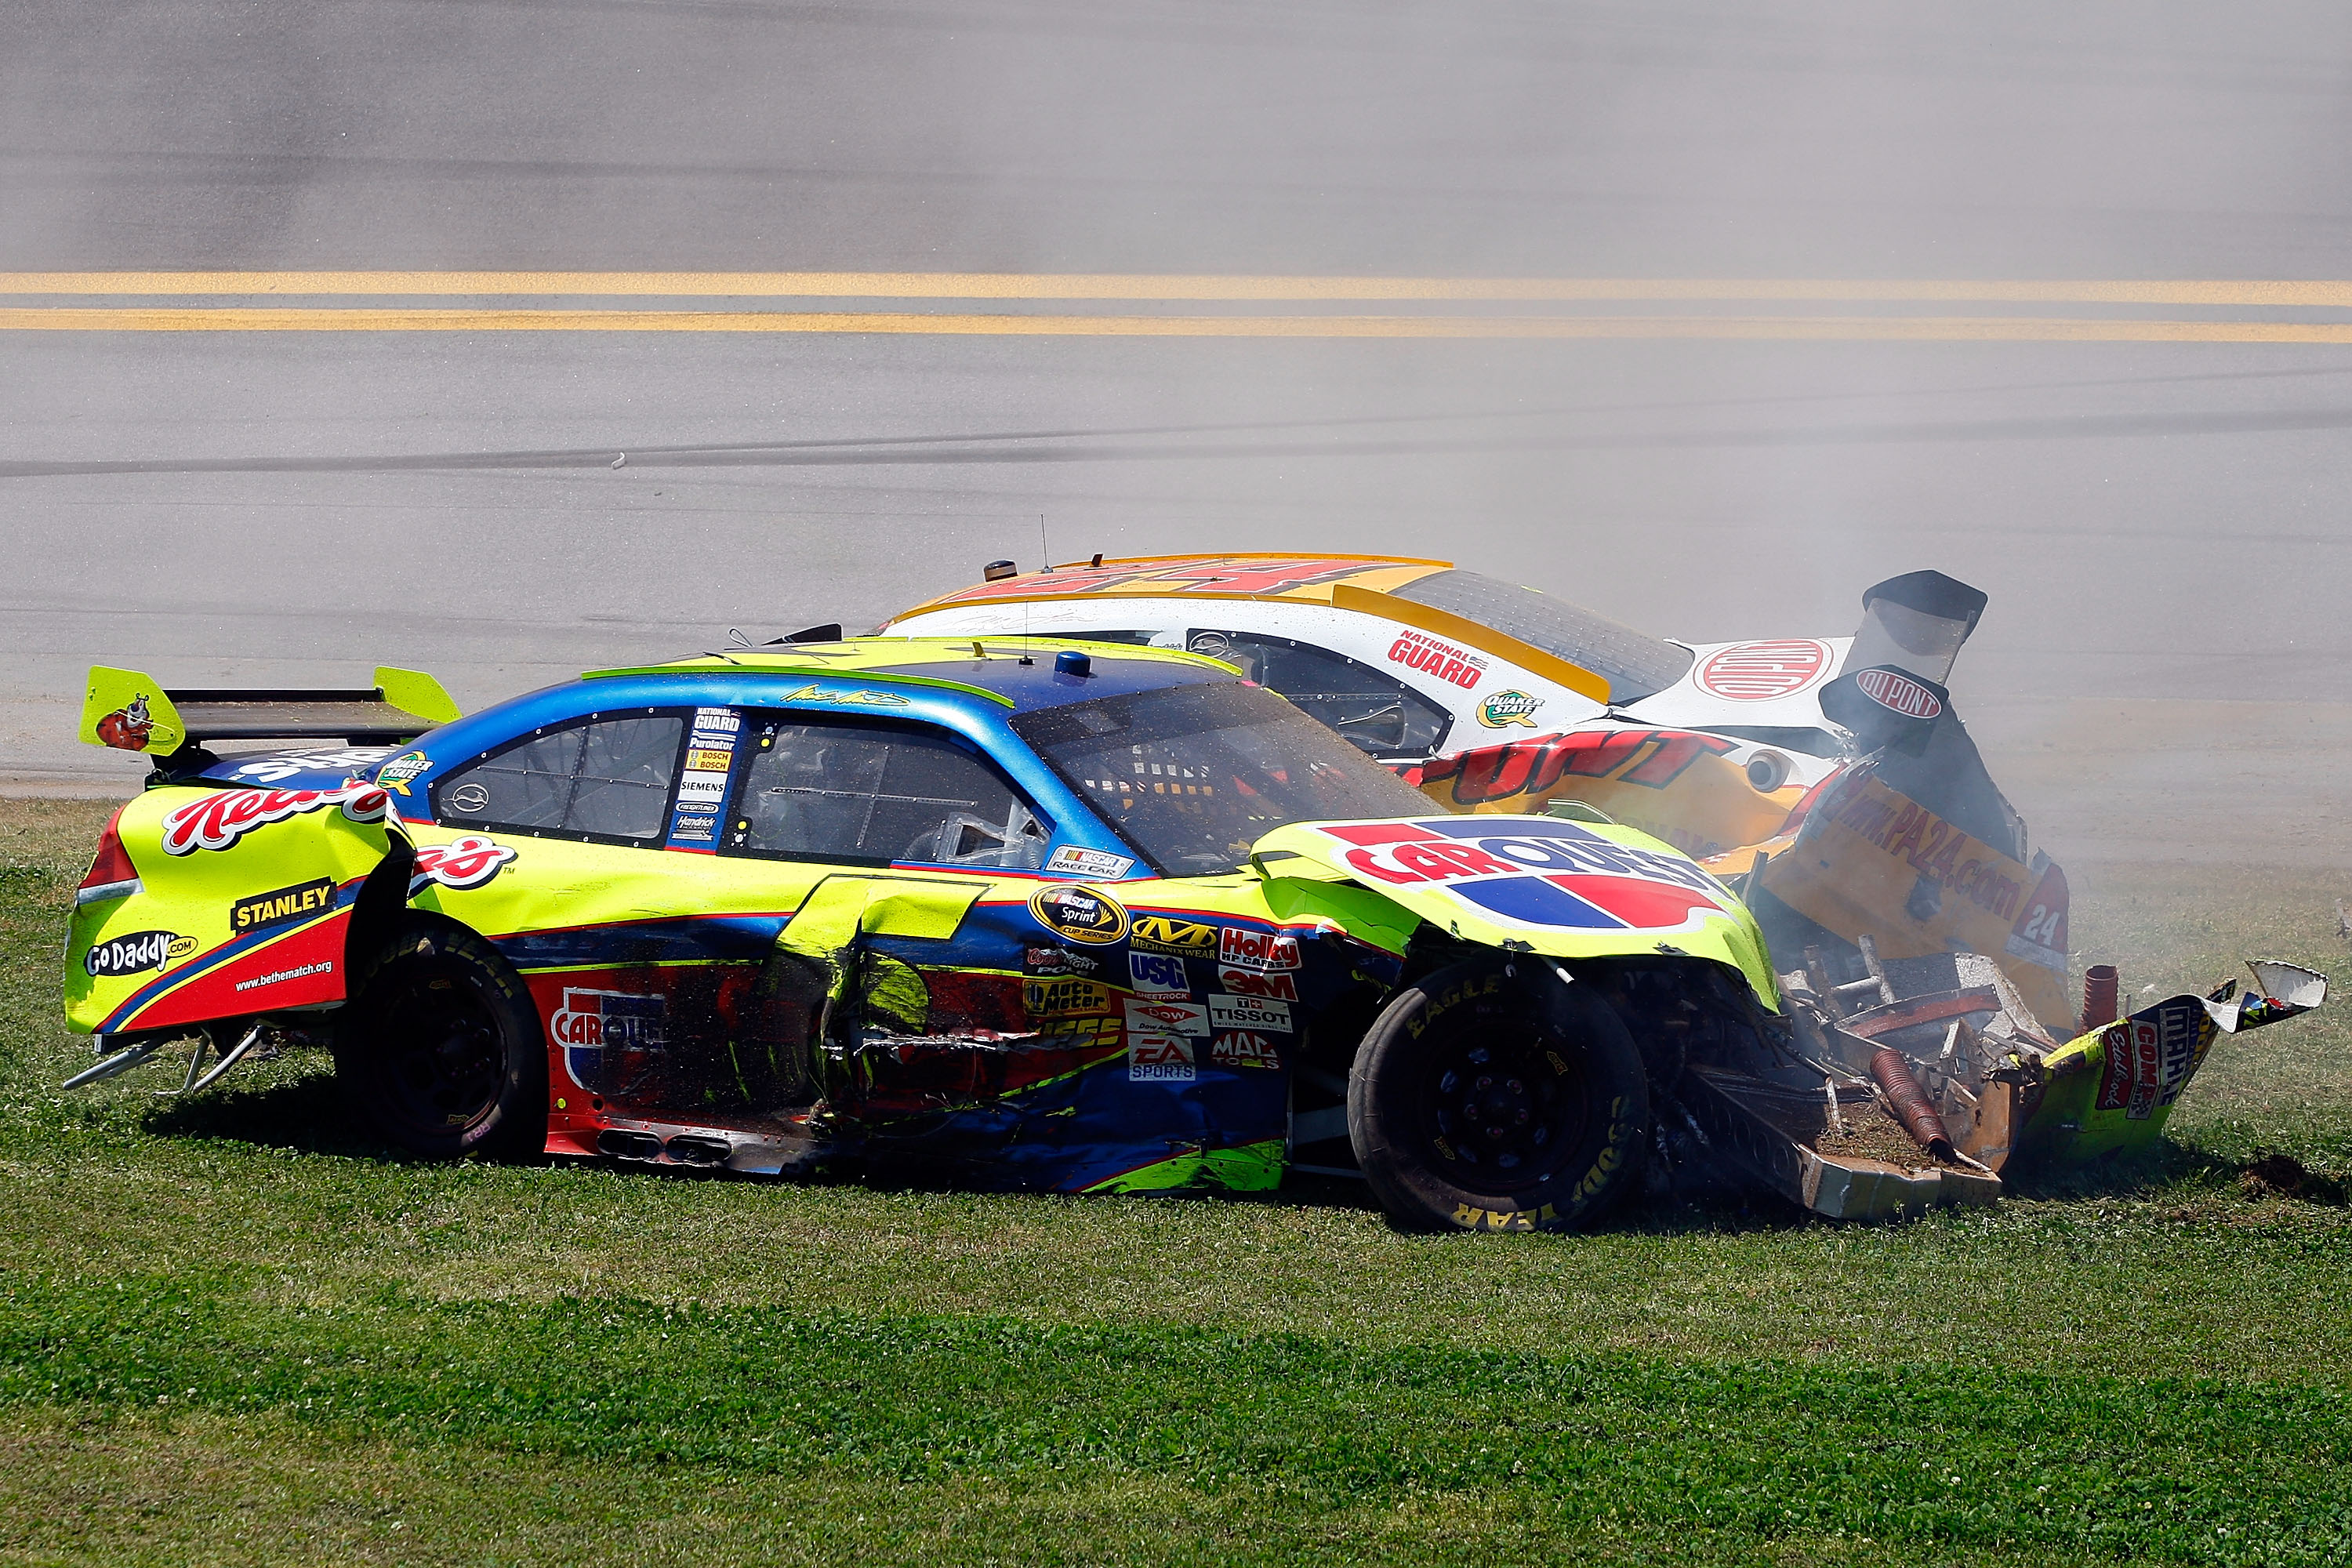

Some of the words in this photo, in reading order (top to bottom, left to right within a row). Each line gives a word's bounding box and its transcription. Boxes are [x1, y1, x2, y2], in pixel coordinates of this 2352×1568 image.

[1400, 629, 1469, 662] NATIONAL
[1387, 638, 1483, 689] GUARD
[1485, 694, 1545, 708] QUAKER
[1492, 702, 1537, 714] STATE
[697, 707, 730, 717] NATIONAL
[694, 715, 740, 732] GUARD
[689, 738, 735, 751] Purolator
[392, 757, 434, 772] QUAKER
[700, 760, 725, 769] BOSCH
[702, 752, 728, 761] BOSCH
[385, 768, 419, 780] STATE
[681, 782, 724, 792] SIEMENS
[677, 815, 716, 829] Hendrick
[1079, 851, 1119, 867] NASCAR
[1053, 862, 1086, 871] RACE
[1089, 866, 1116, 875] CAR
[1345, 837, 1737, 903] CARQUEST
[237, 885, 329, 927] STANLEY
[1058, 894, 1098, 910] NASCAR
[1062, 906, 1098, 923] Sprint
[2024, 904, 2062, 946] 24
[1081, 930, 1114, 940] SERIES
[1130, 936, 1183, 955] MECHANIX
[1185, 948, 1216, 960] WEAR
[1221, 953, 1237, 962] HP
[236, 961, 331, 991] www.bethematch.org
[1131, 952, 1188, 989] USG
[1050, 982, 1094, 996] Auto
[1223, 970, 1299, 1001] 3M
[1136, 991, 1189, 1000] SHEETROCK
[1046, 995, 1105, 1014] Meter
[1212, 1007, 1290, 1025] TISSOT
[1134, 1038, 1189, 1064] EA
[1211, 1032, 1278, 1058] MAC
[2105, 1030, 2129, 1109] Edelbrock
[2136, 1025, 2158, 1099] COMP
[1132, 1065, 1192, 1079] SPORTS
[1450, 1202, 1560, 1232] YEAR
